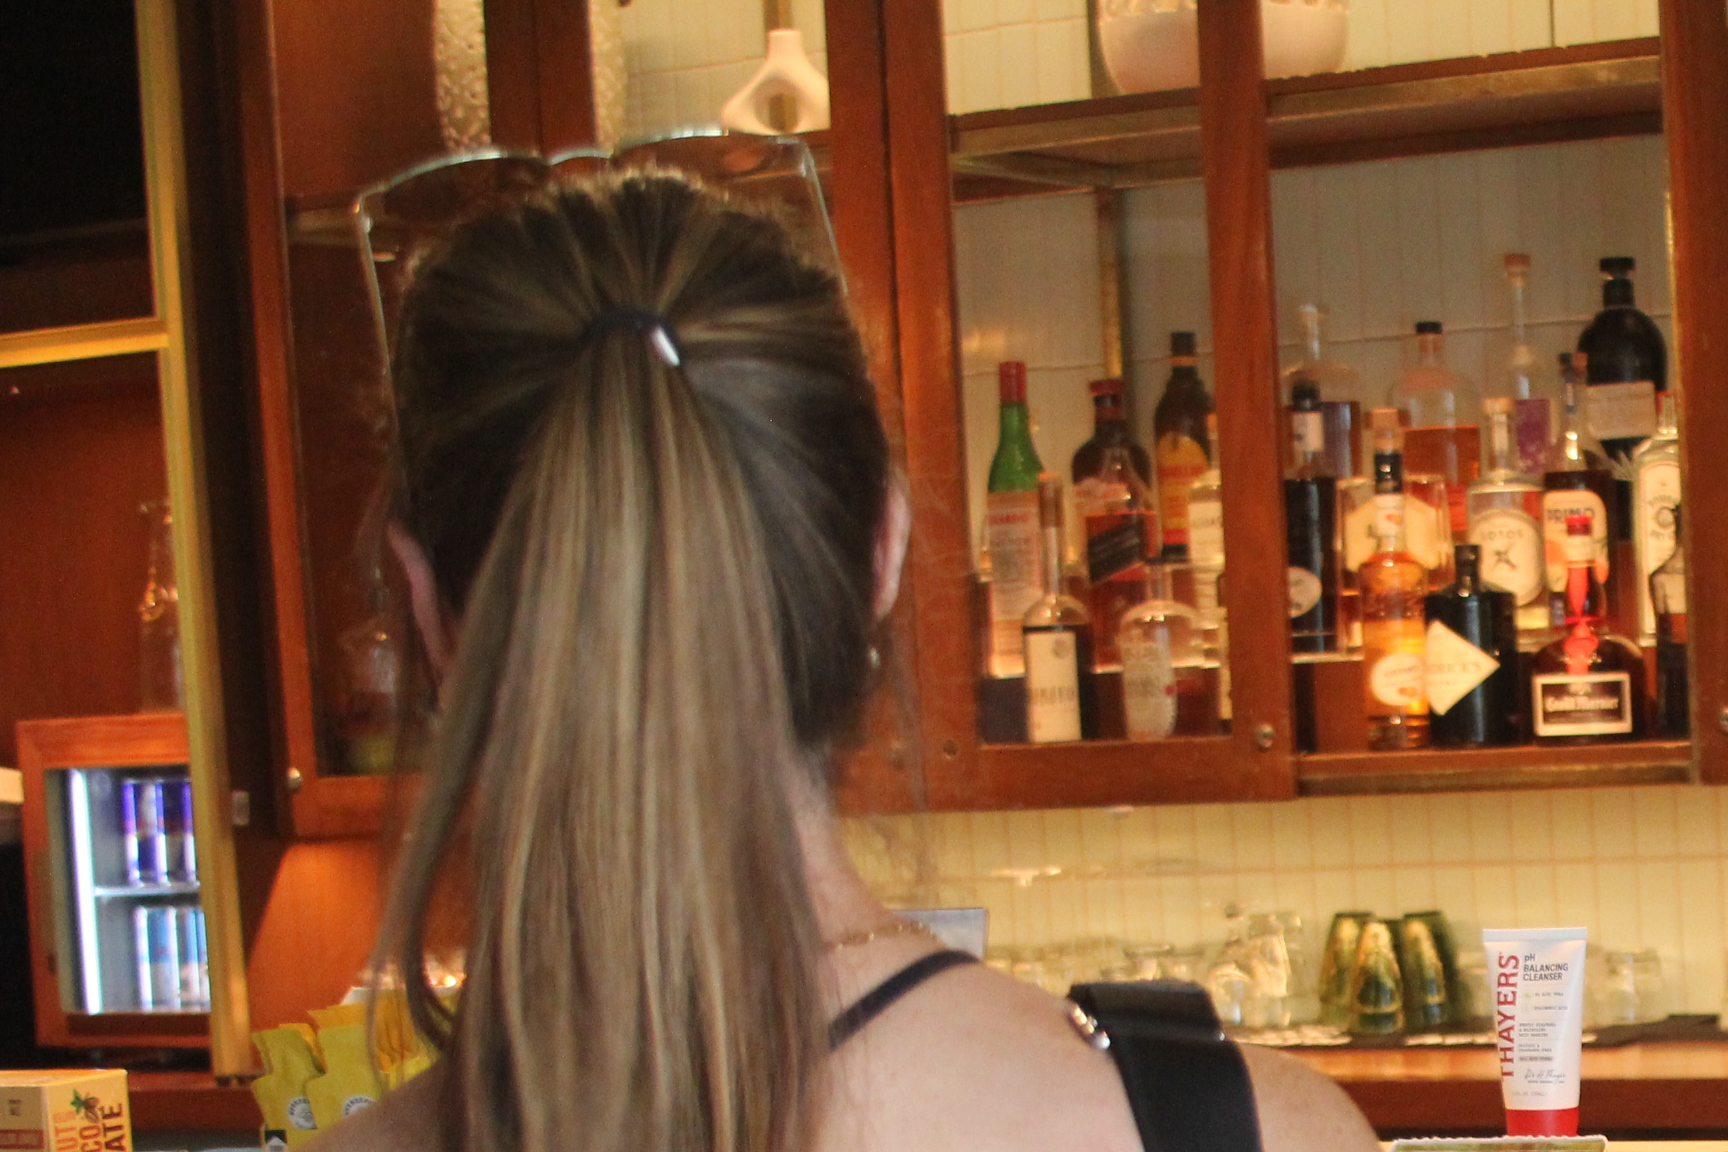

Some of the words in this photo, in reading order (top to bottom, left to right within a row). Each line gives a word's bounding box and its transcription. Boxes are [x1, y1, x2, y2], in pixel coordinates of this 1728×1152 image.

[1524, 953, 1536, 963] pH
[1523, 963, 1569, 973] BALANCING
[1523, 972, 1563, 982] CLEANSER
[1497, 954, 1520, 1081] THAYERS
